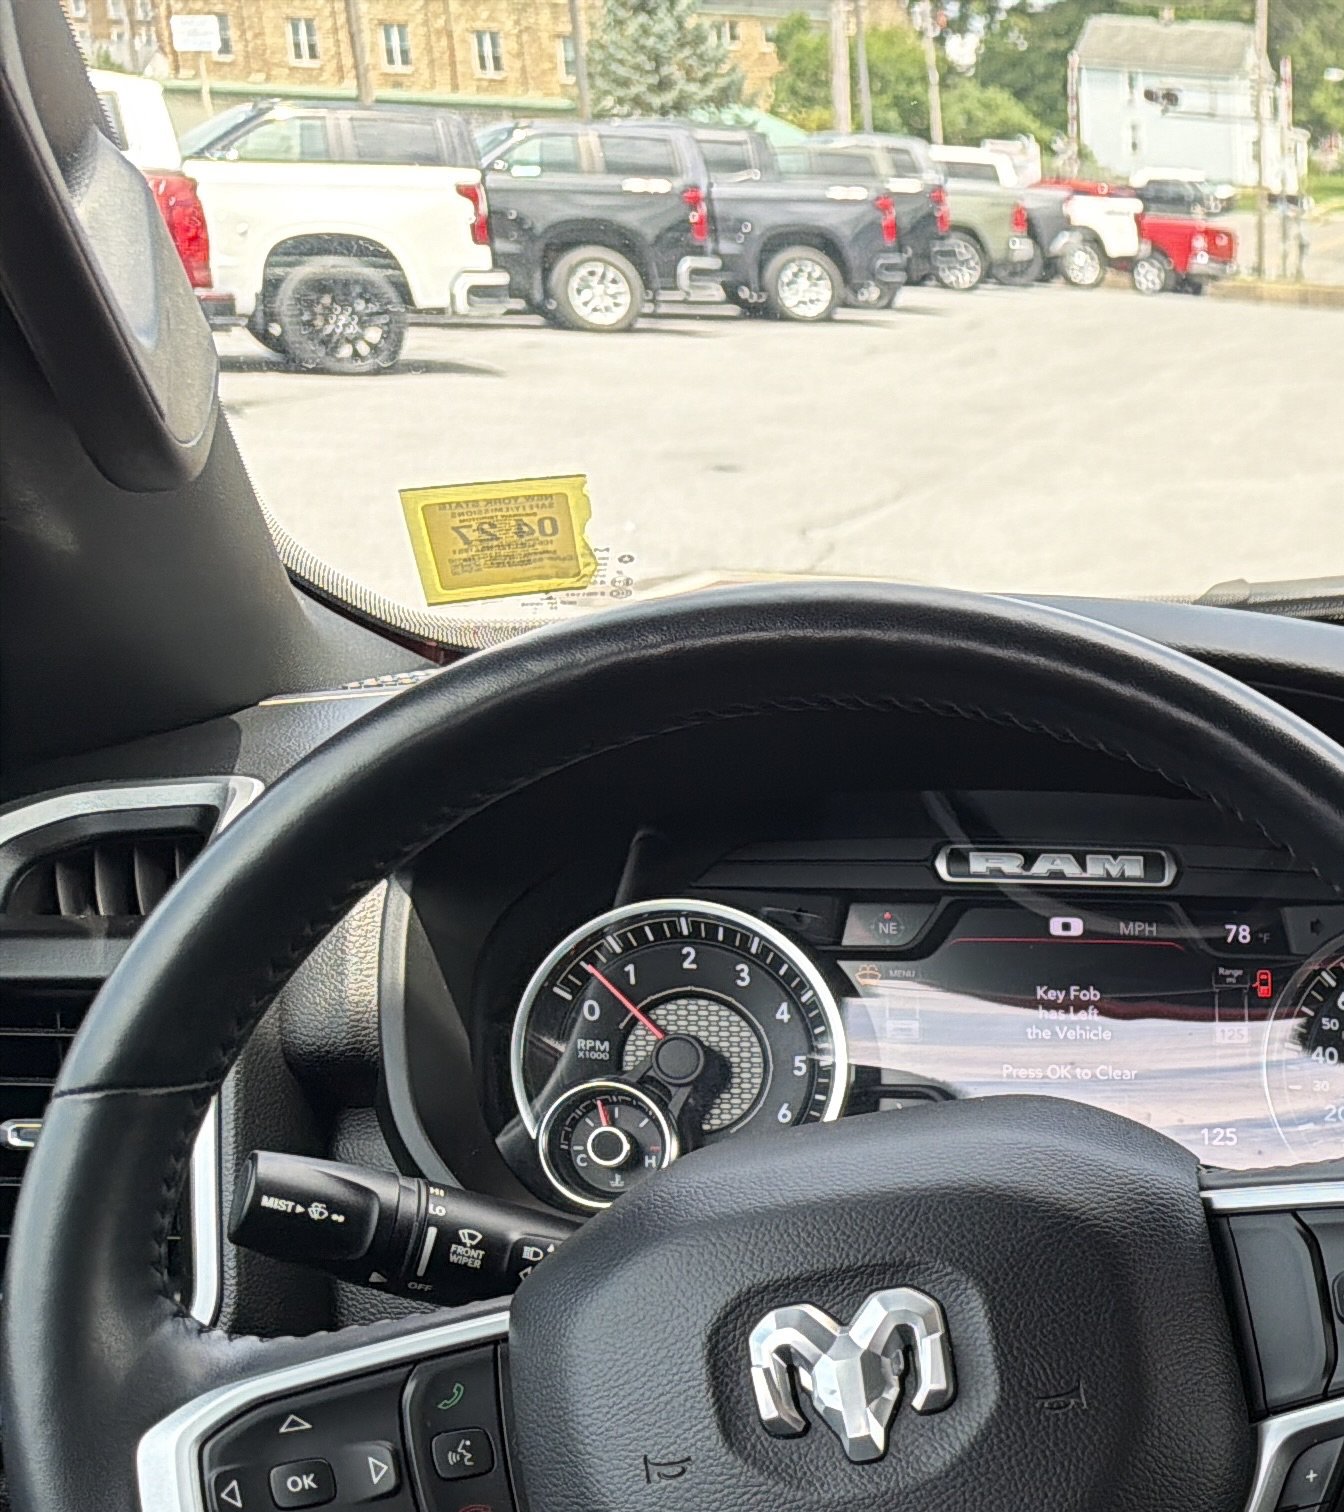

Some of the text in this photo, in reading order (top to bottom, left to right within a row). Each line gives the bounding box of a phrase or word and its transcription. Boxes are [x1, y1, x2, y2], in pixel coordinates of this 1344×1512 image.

[968, 851, 1145, 879] RAM
[879, 922, 898, 935] NE
[1049, 916, 1157, 937] 0 MPH
[1225, 924, 1251, 944] 78
[681, 946, 698, 969] 2
[623, 964, 637, 985] 1
[735, 963, 750, 987] 3
[1218, 966, 1244, 978] Range
[1036, 985, 1101, 1002] Key Fob
[582, 1000, 600, 1021] 0
[775, 1001, 791, 1023] 4
[1038, 1006, 1099, 1021] has Left
[1321, 1017, 1340, 1032] 50
[1026, 1026, 1112, 1041] the Vehicle
[577, 1039, 610, 1052] RPM
[1311, 1046, 1338, 1065] 40
[792, 1055, 808, 1076] 5
[1002, 1065, 1138, 1081] Press OK to Clear
[1313, 1080, 1330, 1092] 30
[777, 1103, 793, 1124] 6
[1200, 1128, 1238, 1147] 125
[576, 1152, 588, 1168] C
[644, 1154, 656, 1168] H
[261, 1195, 295, 1213] MIST
[429, 1203, 446, 1217] LO
[450, 1243, 486, 1260] FRONT
[449, 1252, 482, 1269] WIPER
[407, 1281, 433, 1293] OFF
[286, 1473, 318, 1494] OK
